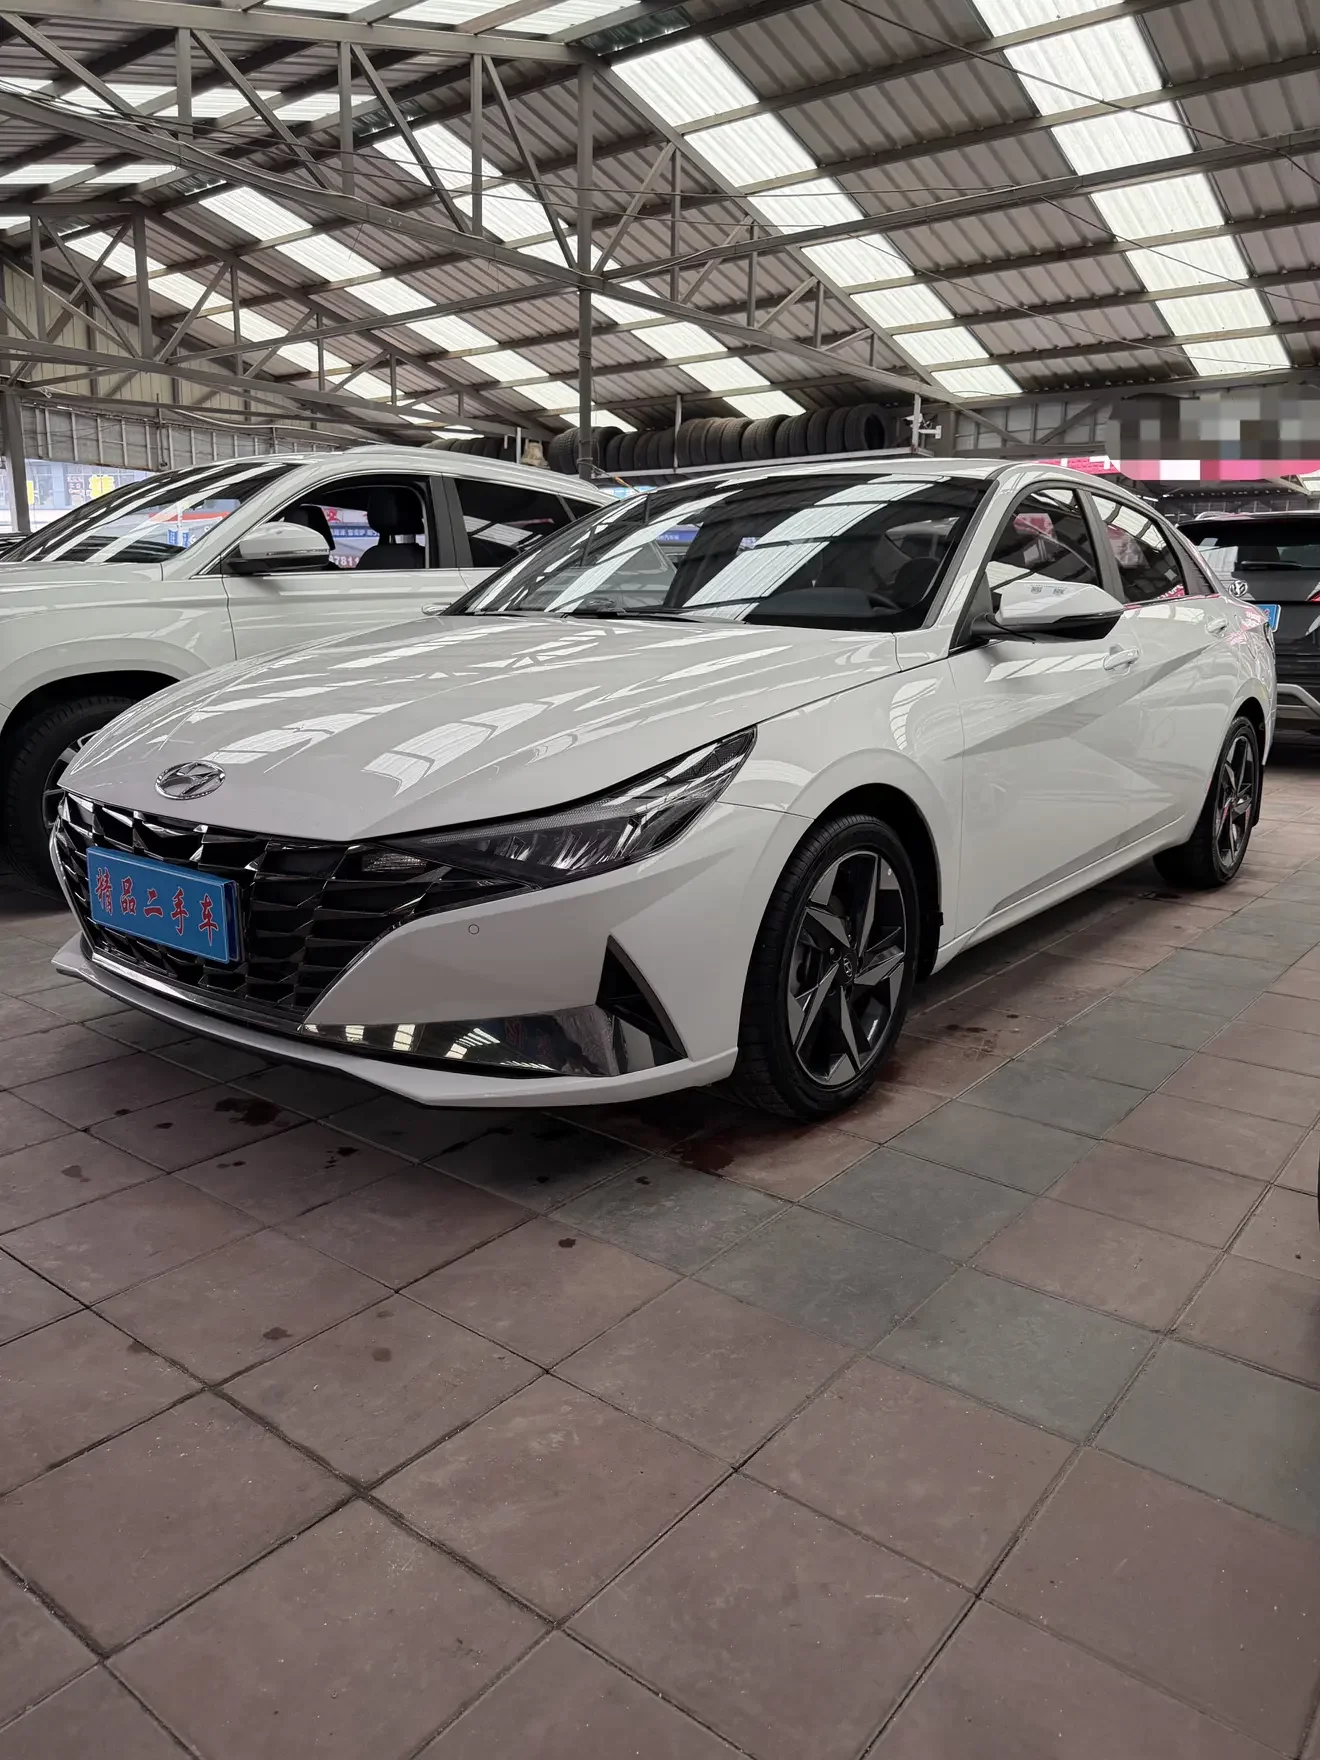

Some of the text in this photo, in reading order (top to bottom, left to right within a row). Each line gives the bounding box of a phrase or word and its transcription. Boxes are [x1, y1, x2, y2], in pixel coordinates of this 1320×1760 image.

[95, 867, 219, 946] 精品二手车
